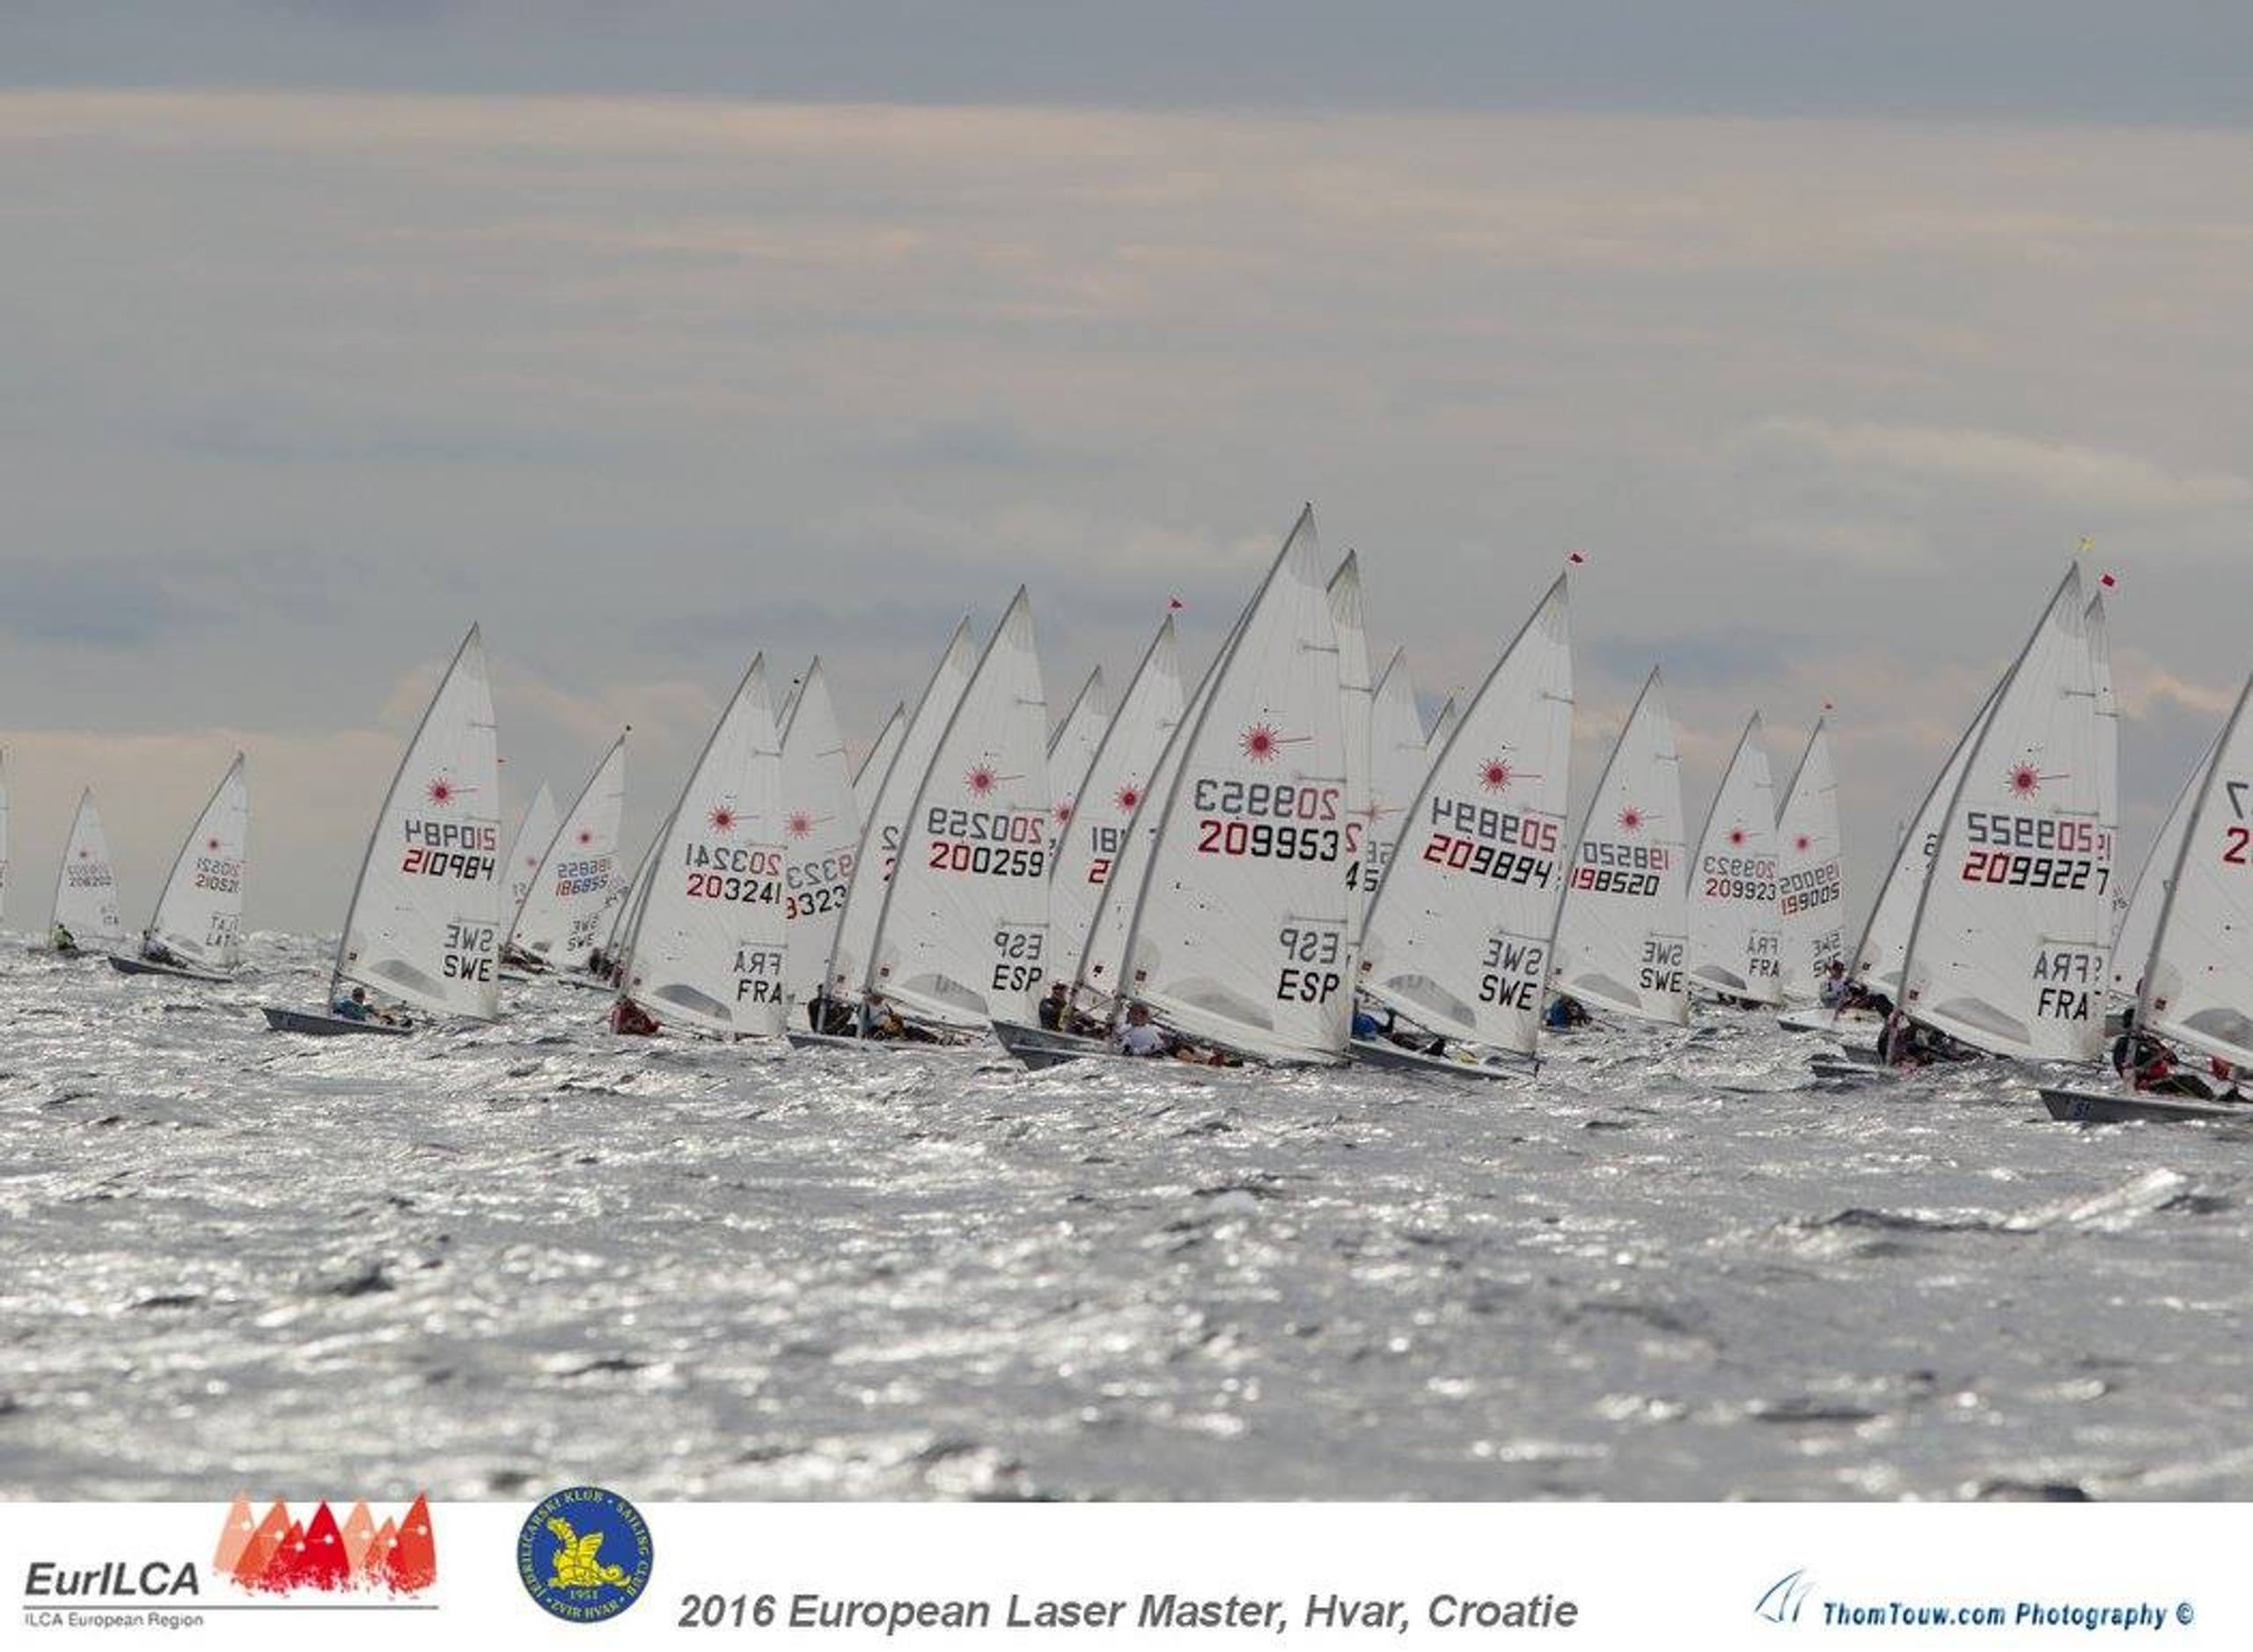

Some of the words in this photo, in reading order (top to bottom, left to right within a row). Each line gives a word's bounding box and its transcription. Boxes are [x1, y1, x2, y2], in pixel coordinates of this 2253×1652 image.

[1197, 820, 1339, 862] 209953
[402, 849, 495, 881] 210984
[928, 841, 1044, 877] 200259
[1423, 833, 1552, 888] 209894
[1963, 851, 2091, 890] 209922
[686, 872, 782, 904] 203241
[1571, 867, 1660, 896] 198520
[1706, 877, 1777, 901] 209923
[1781, 882, 1840, 915] 199005
[443, 954, 492, 982] SWE
[992, 964, 1043, 992] ESP
[1640, 968, 1683, 993] SWE
[1749, 958, 1780, 978] FRA
[737, 979, 782, 1005] FRA
[1277, 968, 1339, 1004] ESP
[1479, 974, 1537, 1010] SWE
[2037, 988, 2088, 1021] FRA
